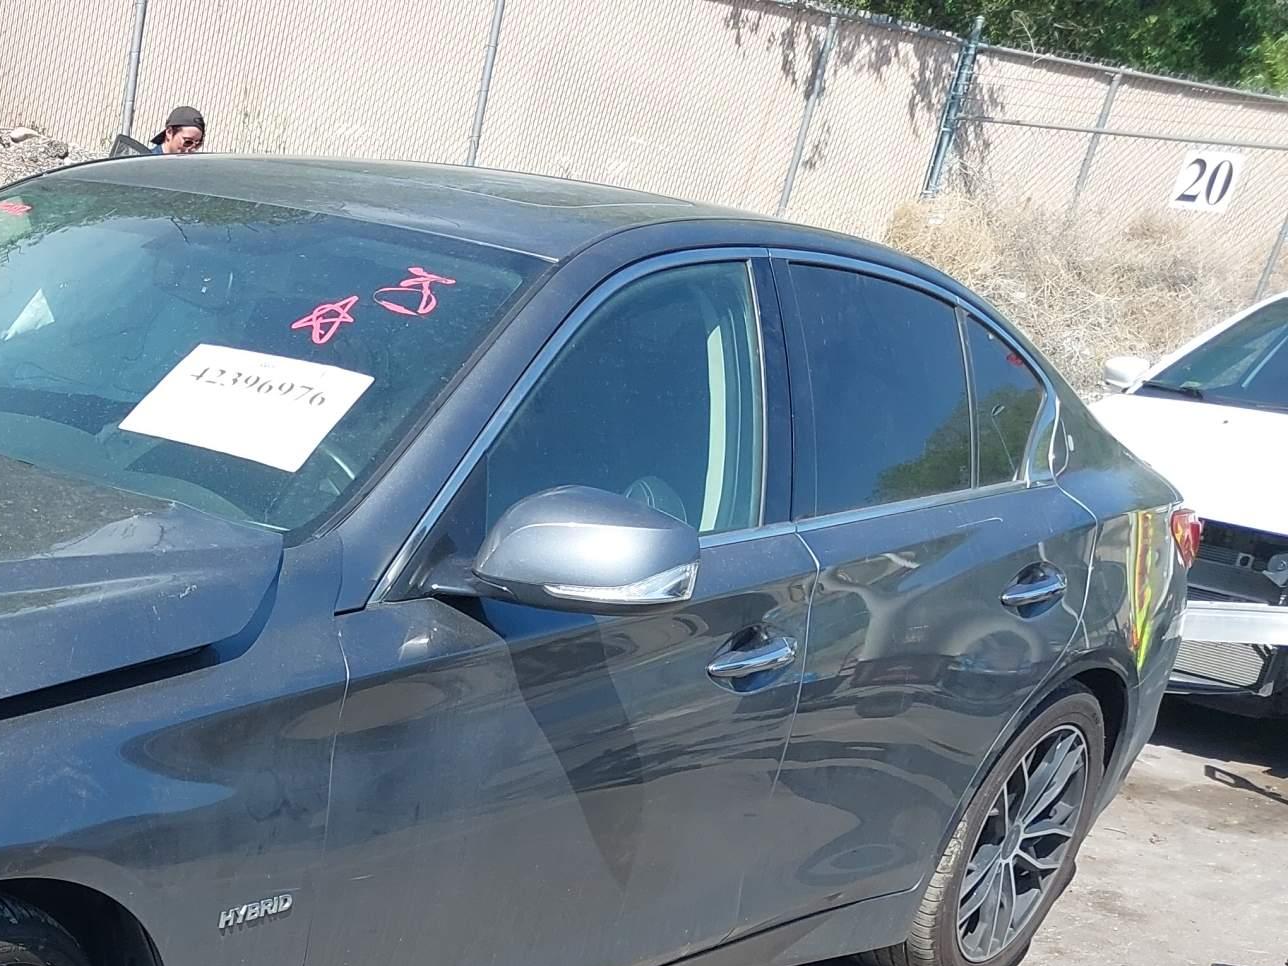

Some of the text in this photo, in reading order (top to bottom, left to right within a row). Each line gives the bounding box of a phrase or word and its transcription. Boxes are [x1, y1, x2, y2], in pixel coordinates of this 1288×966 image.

[1175, 158, 1234, 206] 20
[189, 366, 327, 407] 42396976
[218, 893, 293, 929] HYBRID
